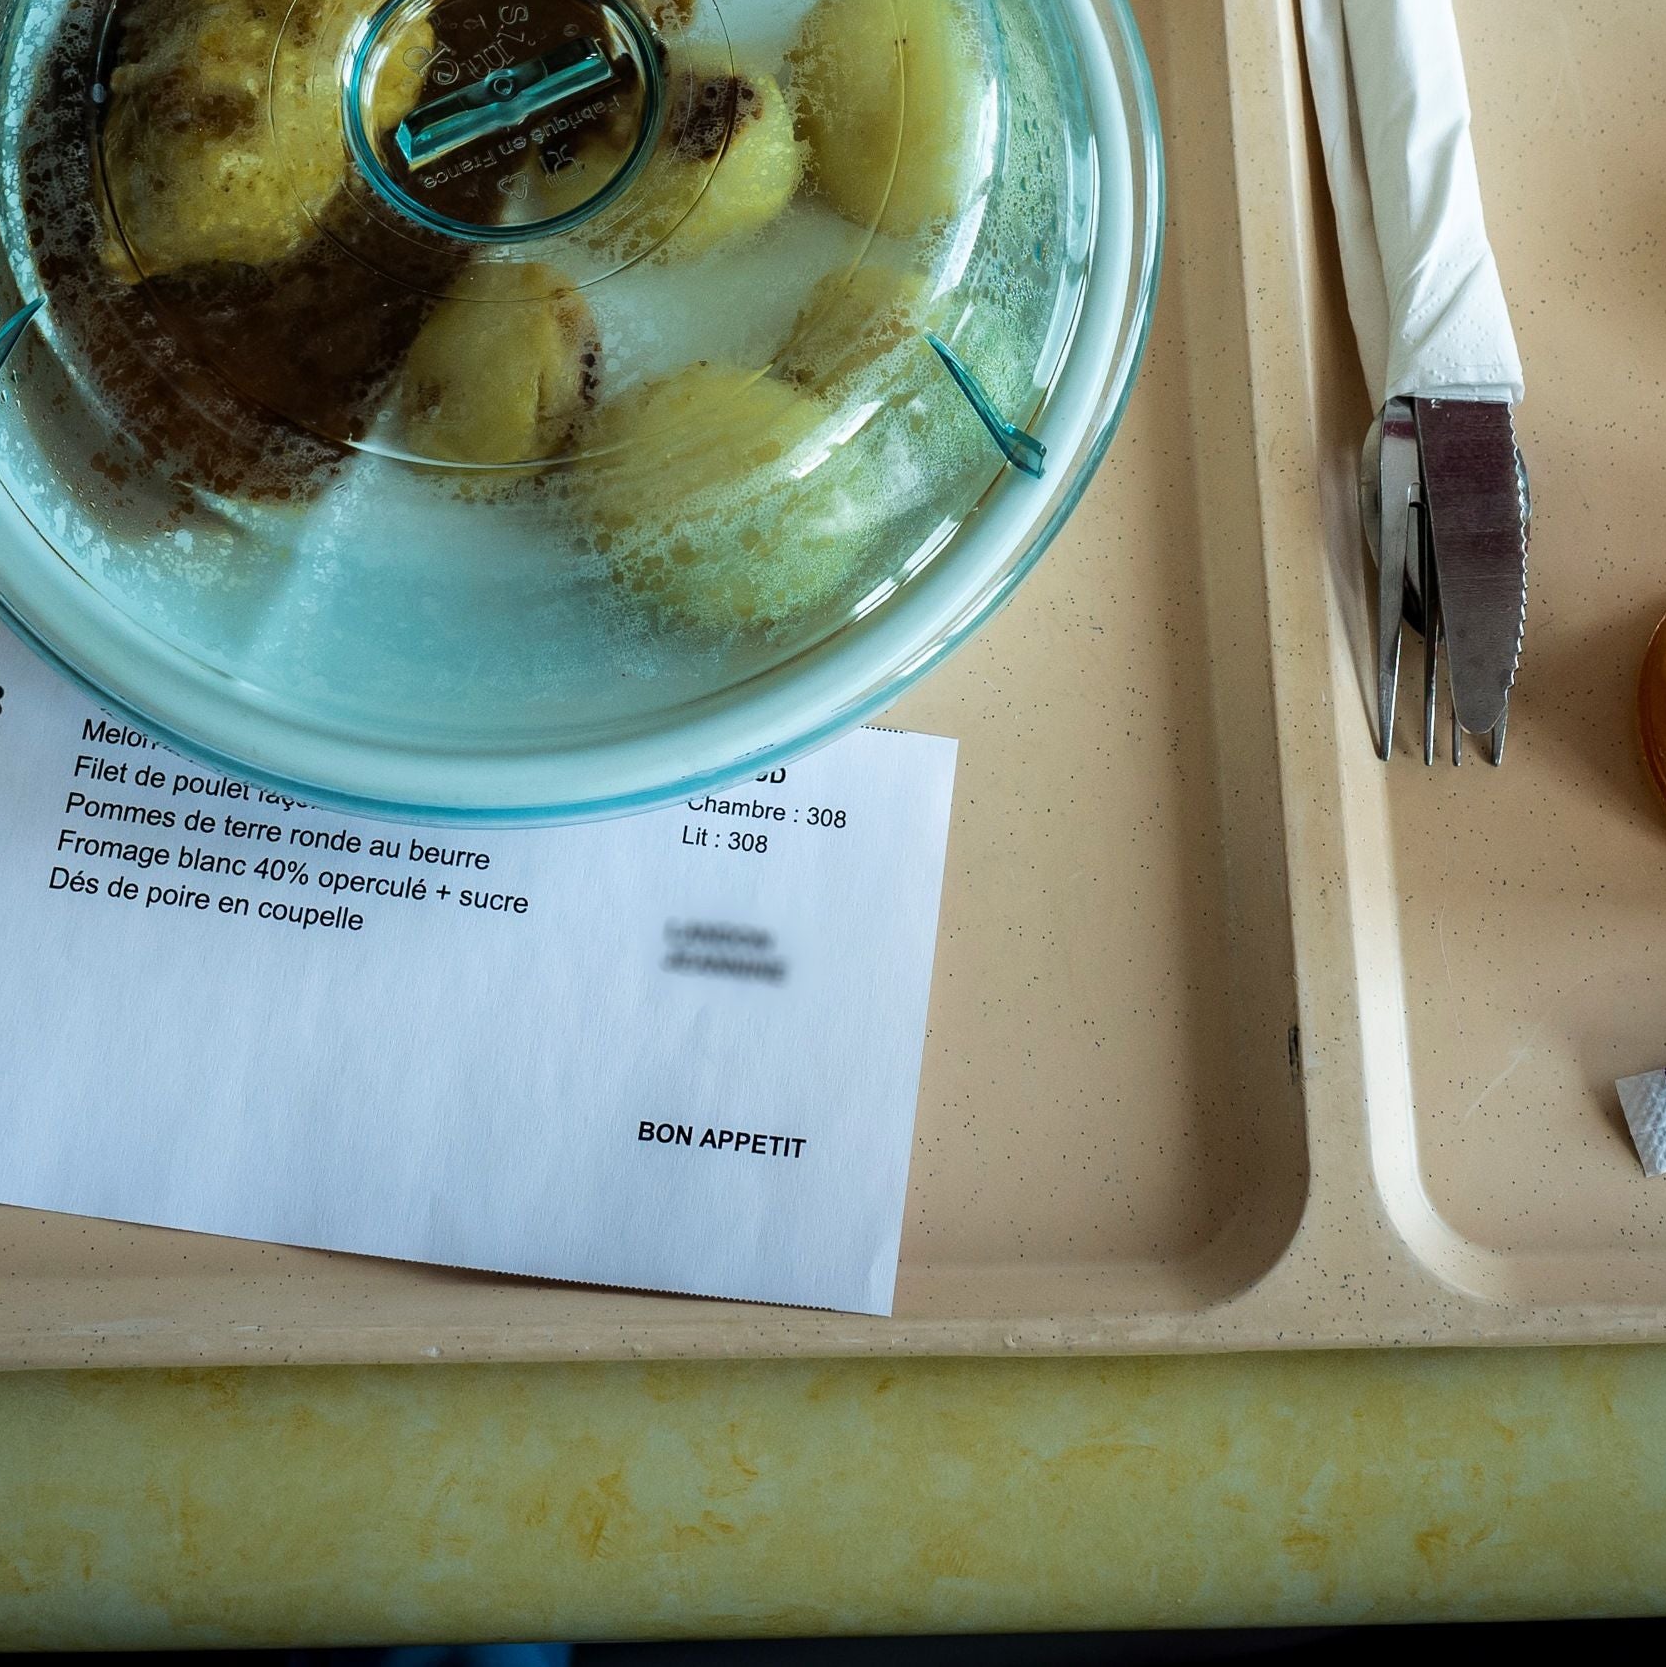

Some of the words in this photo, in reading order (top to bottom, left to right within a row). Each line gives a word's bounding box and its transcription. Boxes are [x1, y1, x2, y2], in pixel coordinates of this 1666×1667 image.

[423, 150, 498, 189] France
[74, 755, 128, 783] Filet
[135, 766, 166, 788] de
[173, 775, 250, 801] poulet
[65, 792, 176, 828] Pommes
[184, 809, 215, 833] de
[224, 816, 281, 842] terre
[290, 828, 361, 853] ronde
[369, 839, 401, 859] au
[409, 839, 490, 870] beurre
[806, 807, 847, 828] 308
[682, 825, 708, 846] Lit
[728, 832, 768, 853] 308
[57, 829, 170, 868] Fromage
[178, 846, 246, 876] blanc
[254, 857, 309, 885] 40%
[318, 871, 427, 901] operculé
[459, 889, 529, 914] sucre
[49, 866, 99, 894] Dés
[107, 876, 139, 900] de
[145, 885, 210, 909] poire
[218, 896, 249, 915] en
[258, 901, 363, 930] coupelle
[638, 1121, 693, 1146] BON
[699, 1128, 807, 1158] APPETIT
